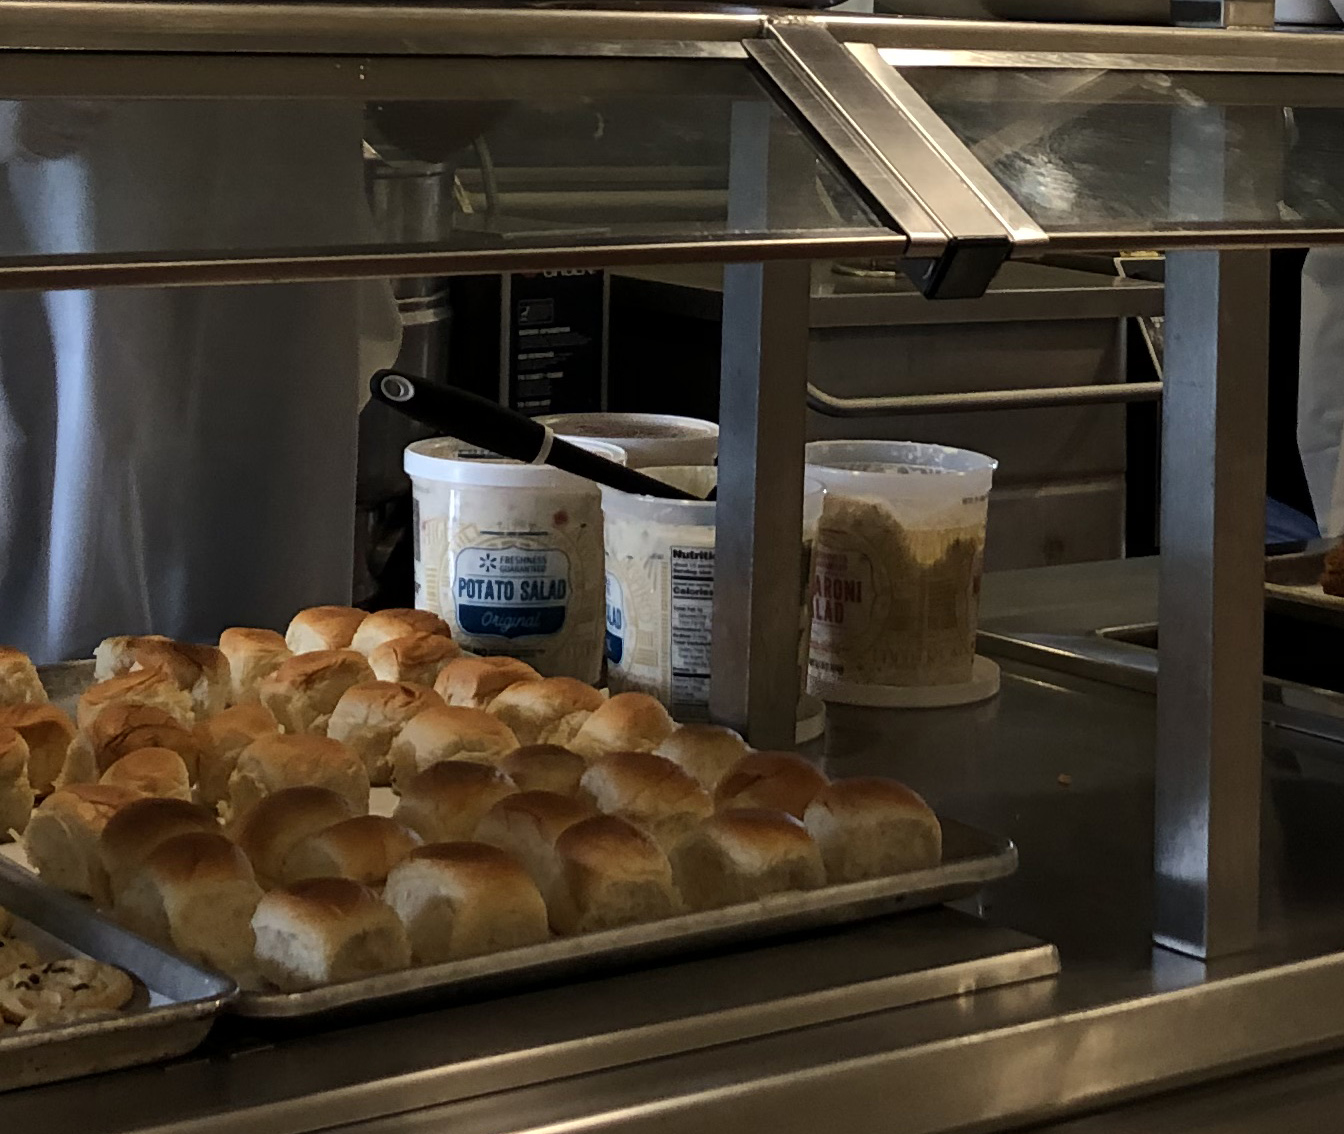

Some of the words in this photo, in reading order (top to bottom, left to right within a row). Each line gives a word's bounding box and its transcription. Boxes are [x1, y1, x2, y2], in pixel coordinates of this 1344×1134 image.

[459, 577, 514, 601] POTATO
[520, 579, 566, 601] SALAD
[814, 574, 862, 603] ARONI
[481, 610, 540, 633] Original
[816, 598, 844, 623] LAD
